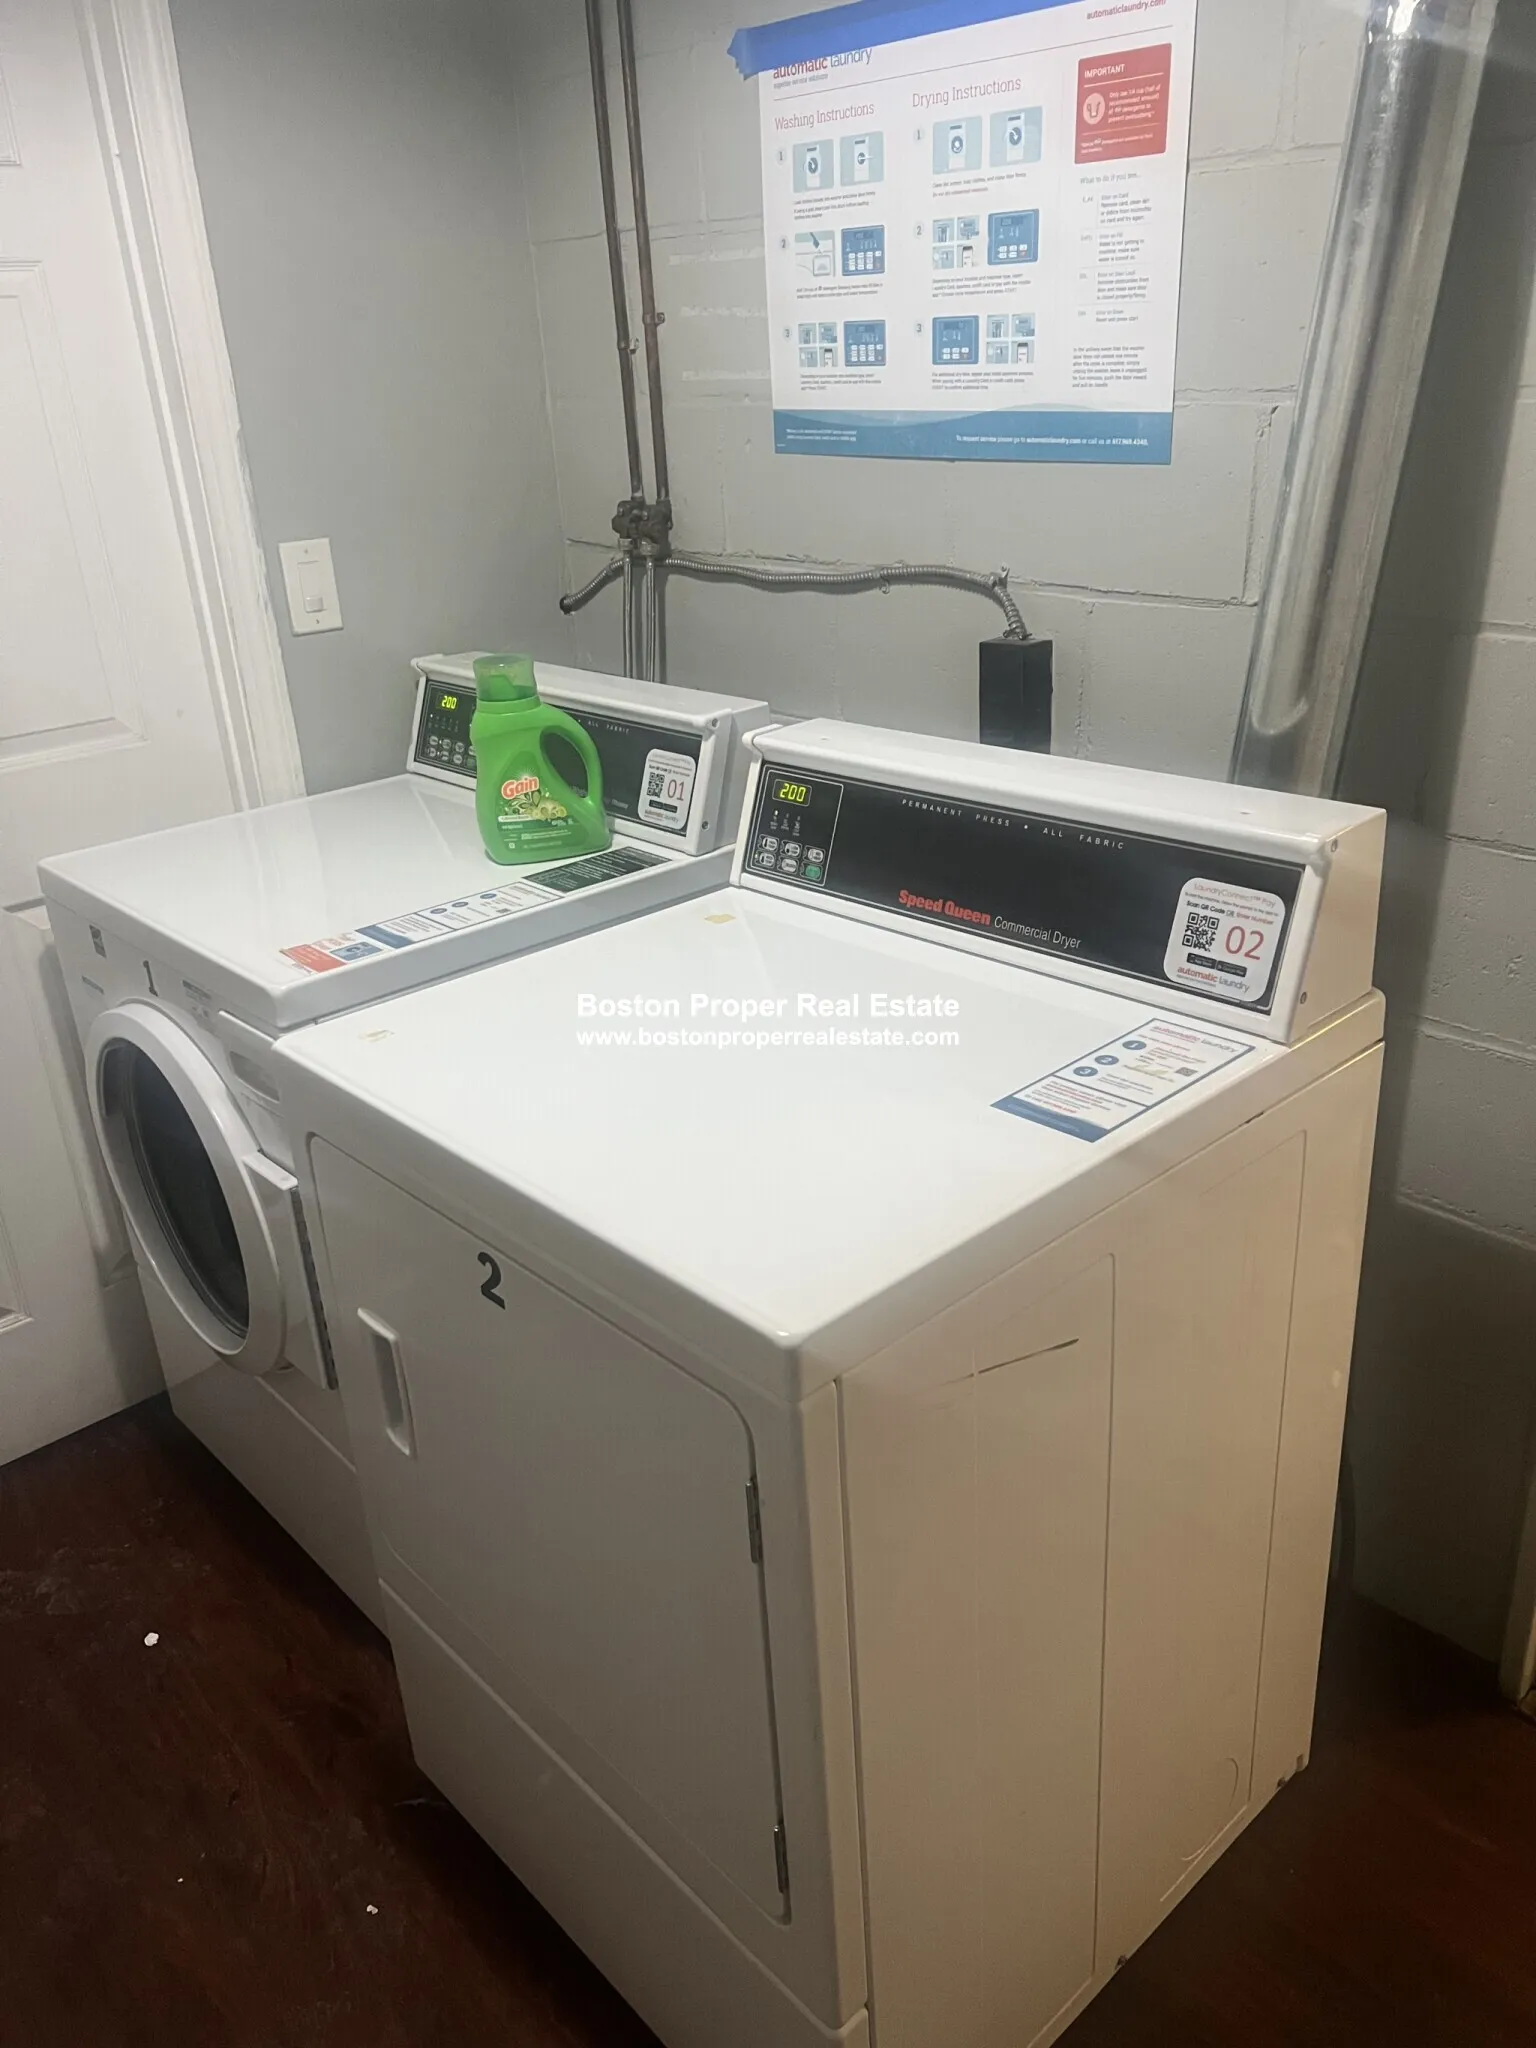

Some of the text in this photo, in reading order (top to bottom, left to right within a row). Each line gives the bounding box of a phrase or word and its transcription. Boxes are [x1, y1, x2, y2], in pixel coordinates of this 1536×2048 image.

[1086, 0, 1166, 20] automaticlaundry.com
[773, 58, 828, 79] automatic
[1085, 64, 1126, 79] IMPORTANT
[912, 78, 1022, 109] Drying Instructions
[774, 103, 875, 131] Washing Instructions
[916, 225, 922, 236] 2
[781, 238, 786, 249] 2
[784, 328, 790, 338] 3
[916, 323, 922, 333] 3
[441, 695, 458, 710] 200
[606, 724, 630, 735] FABRIC
[501, 776, 539, 800] Gain
[667, 779, 685, 801] 01
[780, 783, 806, 802] 200
[902, 799, 1125, 850] PERMANENT PRESS ALL FABRIC
[1186, 900, 1200, 909] Scan
[1200, 903, 1210, 911] QR
[1210, 905, 1226, 914] Code
[899, 889, 1082, 950] Speed Queen Commercial Dryer
[1225, 925, 1264, 960] 02
[142, 960, 159, 998] 1
[1177, 965, 1218, 983] automatic
[1219, 976, 1250, 994] laundry
[1152, 1026, 1201, 1041] automatic
[477, 1251, 506, 1310] 2
